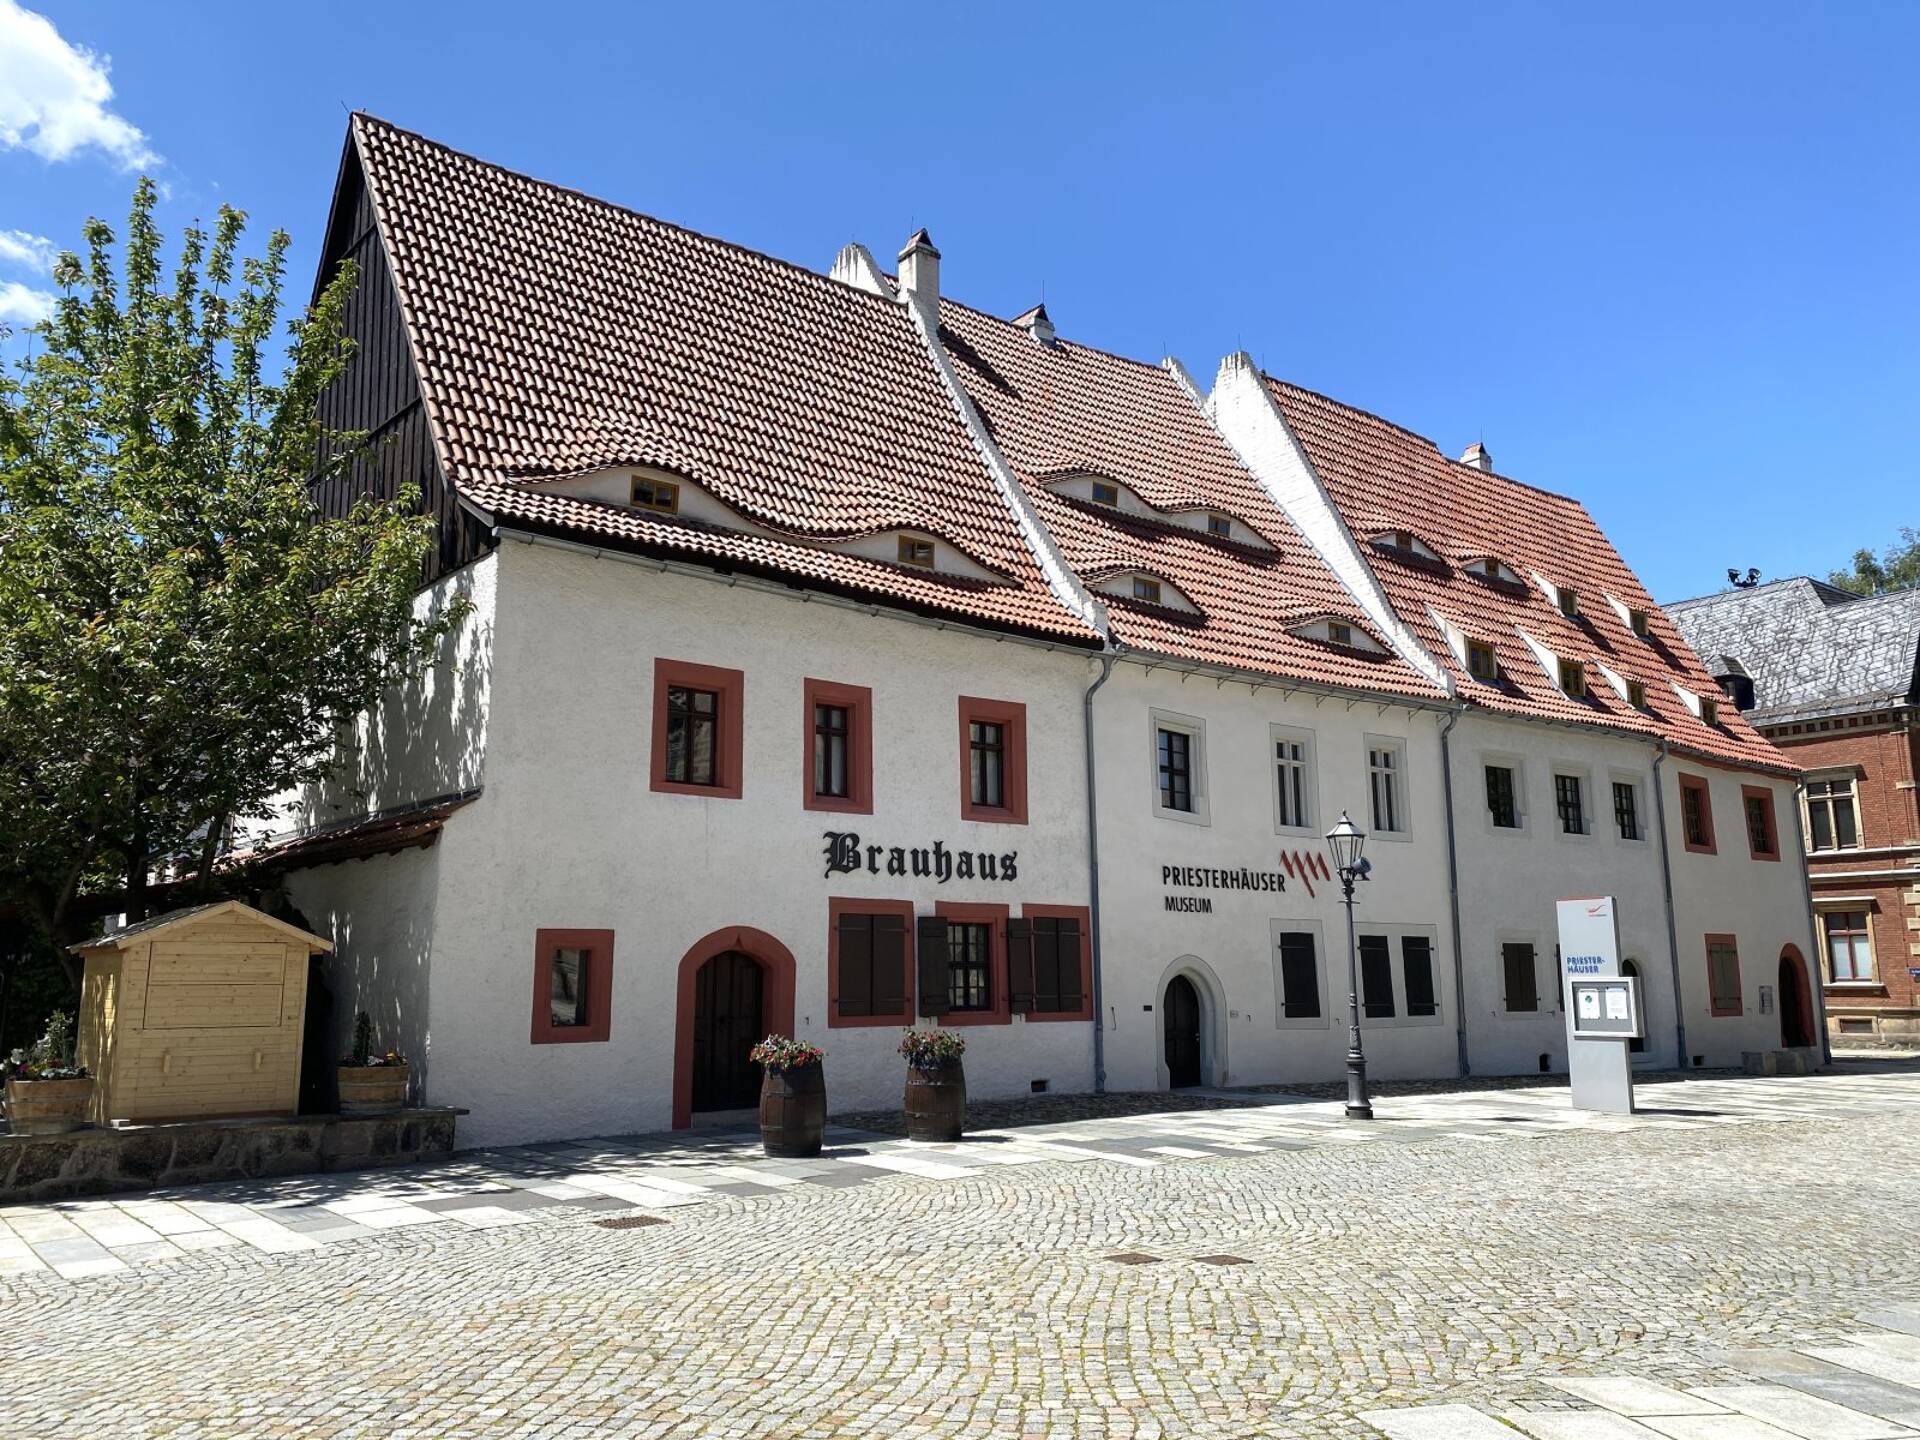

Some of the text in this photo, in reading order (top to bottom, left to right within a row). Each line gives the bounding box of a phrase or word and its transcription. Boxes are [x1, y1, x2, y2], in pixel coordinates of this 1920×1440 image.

[823, 831, 1018, 884] Brauhaus
[1163, 866, 1286, 892] PRIESTERHÄUSER
[1165, 896, 1212, 914] MUSEUM
[1567, 956, 1605, 964] PRIESTER-
